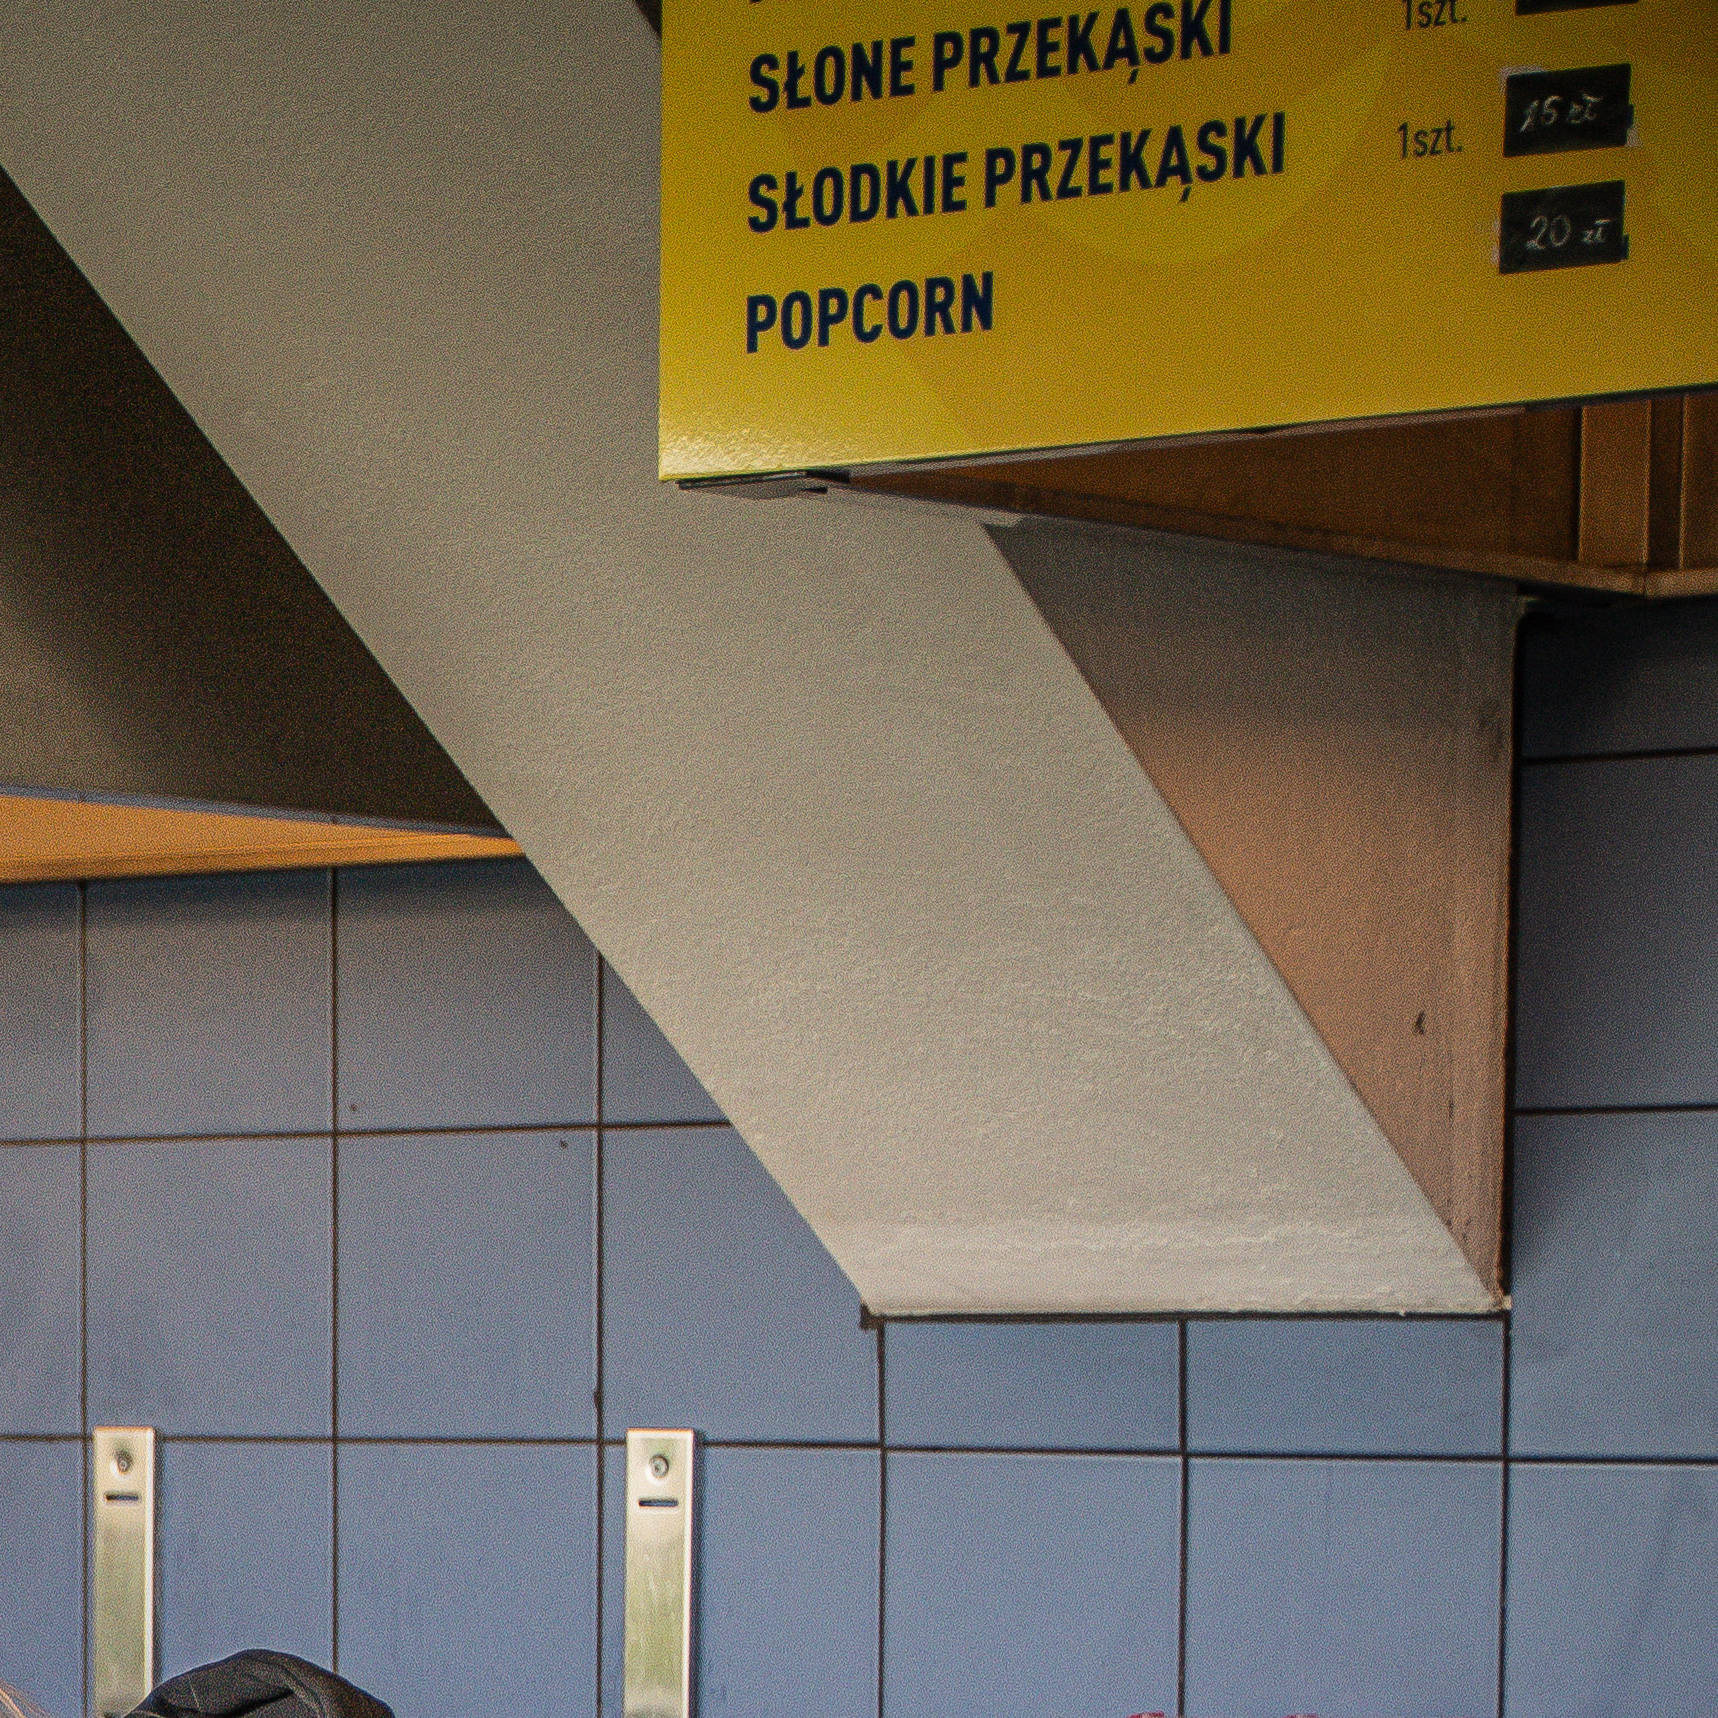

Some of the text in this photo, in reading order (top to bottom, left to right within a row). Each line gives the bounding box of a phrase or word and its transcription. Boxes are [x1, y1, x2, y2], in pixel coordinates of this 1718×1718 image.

[749, 33, 917, 114] SŁONE
[931, 0, 1233, 92] PRZEKĄSKI
[747, 152, 968, 234] SŁODKIE
[983, 111, 1287, 210] PRZEKĄSKI
[1397, 119, 1463, 159] 1szt.
[745, 272, 995, 354] POPCORN
[1524, 214, 1571, 251] 20
